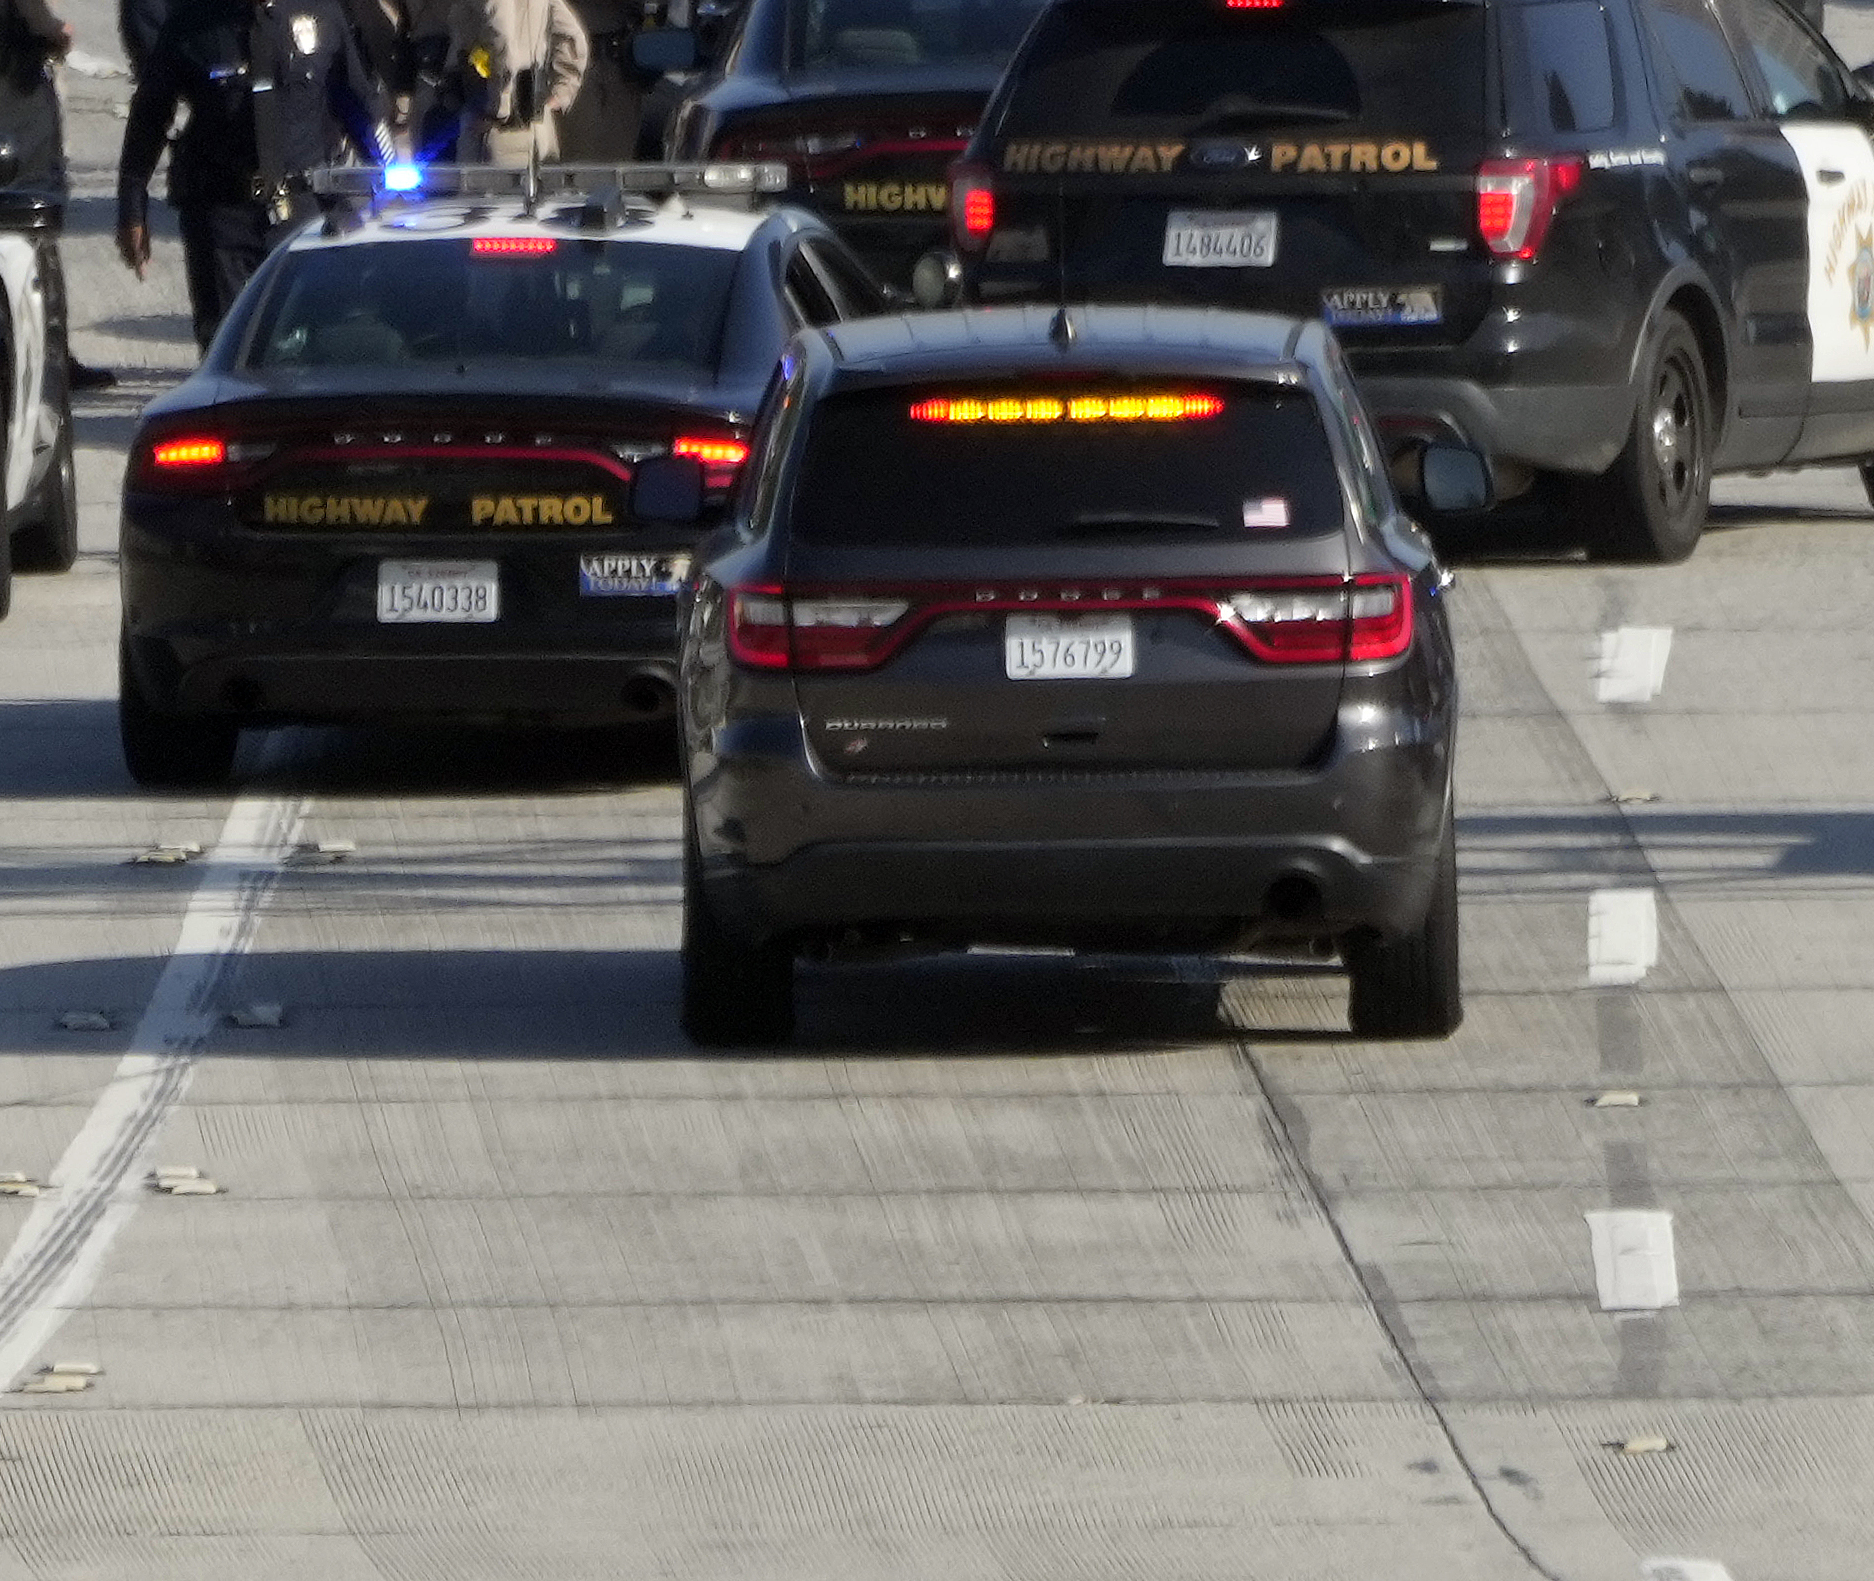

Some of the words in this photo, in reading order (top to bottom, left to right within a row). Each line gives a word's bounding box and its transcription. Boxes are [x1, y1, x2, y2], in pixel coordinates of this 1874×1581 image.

[1003, 141, 1186, 173] HIGHWAY
[1271, 141, 1438, 173] PATROL
[844, 182, 947, 211] HIGHW
[264, 494, 428, 525] HIGHWAY
[472, 496, 613, 526] PATROL
[588, 556, 657, 577] APPLY
[387, 584, 488, 613] 1540338
[1015, 638, 1123, 669] 1576799
